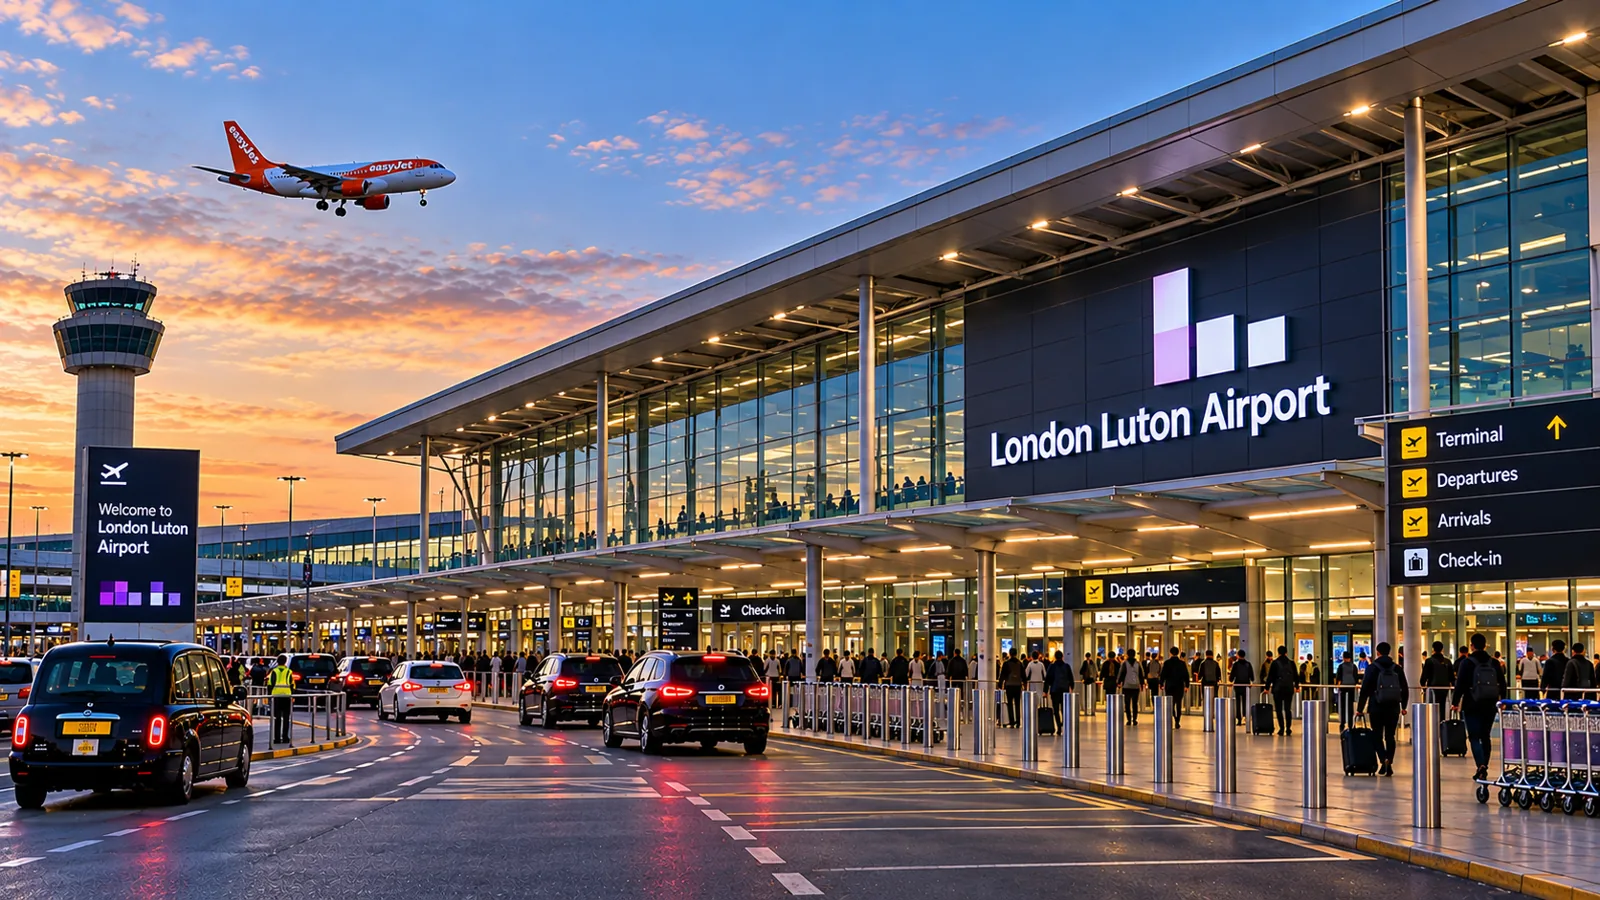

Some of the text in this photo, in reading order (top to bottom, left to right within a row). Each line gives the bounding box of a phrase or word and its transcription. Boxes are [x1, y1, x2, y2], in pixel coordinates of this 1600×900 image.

[990, 375, 1331, 467] London Luton Airport
[1436, 425, 1505, 449] Terminal
[1437, 468, 1519, 491] Departures
[98, 502, 173, 517] Welcome to
[1437, 509, 1492, 529] Arrivals
[98, 520, 189, 535] London Luton
[97, 540, 150, 557] Airport
[1438, 550, 1503, 569] Check-in
[1110, 581, 1180, 602] Departures
[741, 604, 786, 616] Check-in
